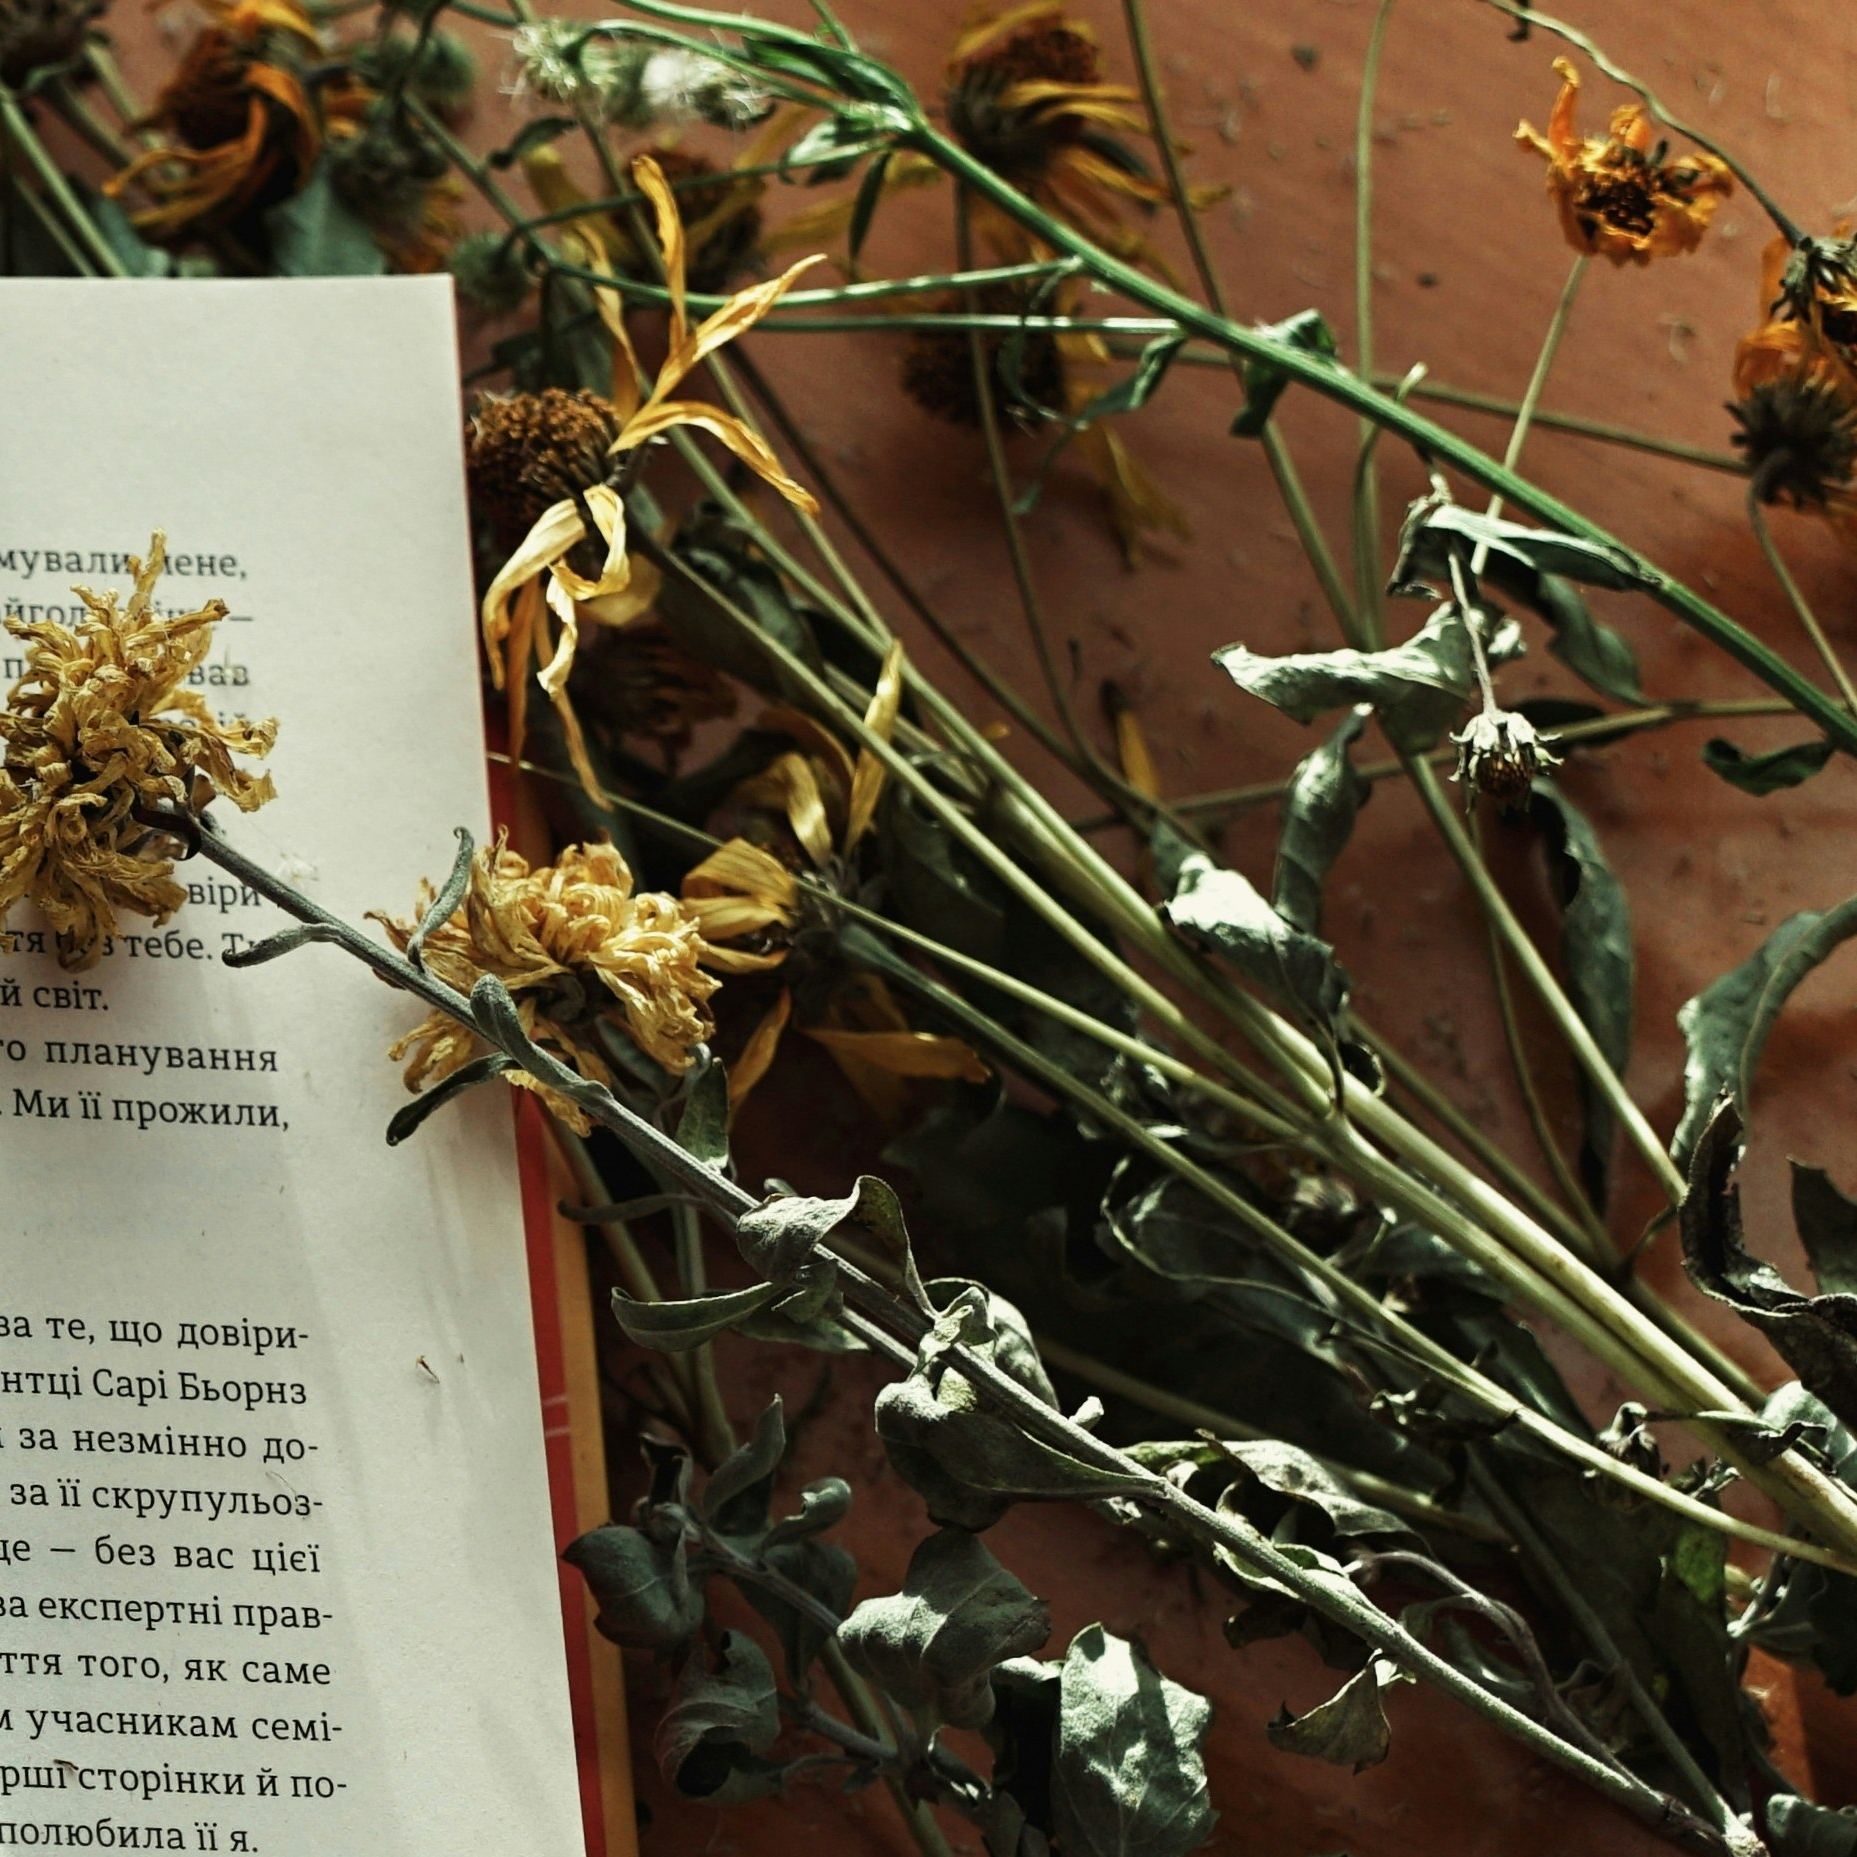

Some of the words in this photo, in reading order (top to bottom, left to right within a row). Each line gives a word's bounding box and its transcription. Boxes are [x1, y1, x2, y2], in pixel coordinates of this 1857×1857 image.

[32, 978, 109, 1012] світ.
[12, 1087, 71, 1120] Ми
[77, 1089, 103, 1121] її
[111, 1098, 290, 1132] прожили,
[91, 1367, 169, 1408] Сарі
[177, 1371, 308, 1412] Бьорнз
[193, 1821, 219, 1852] її
[229, 1829, 259, 1854] я.
